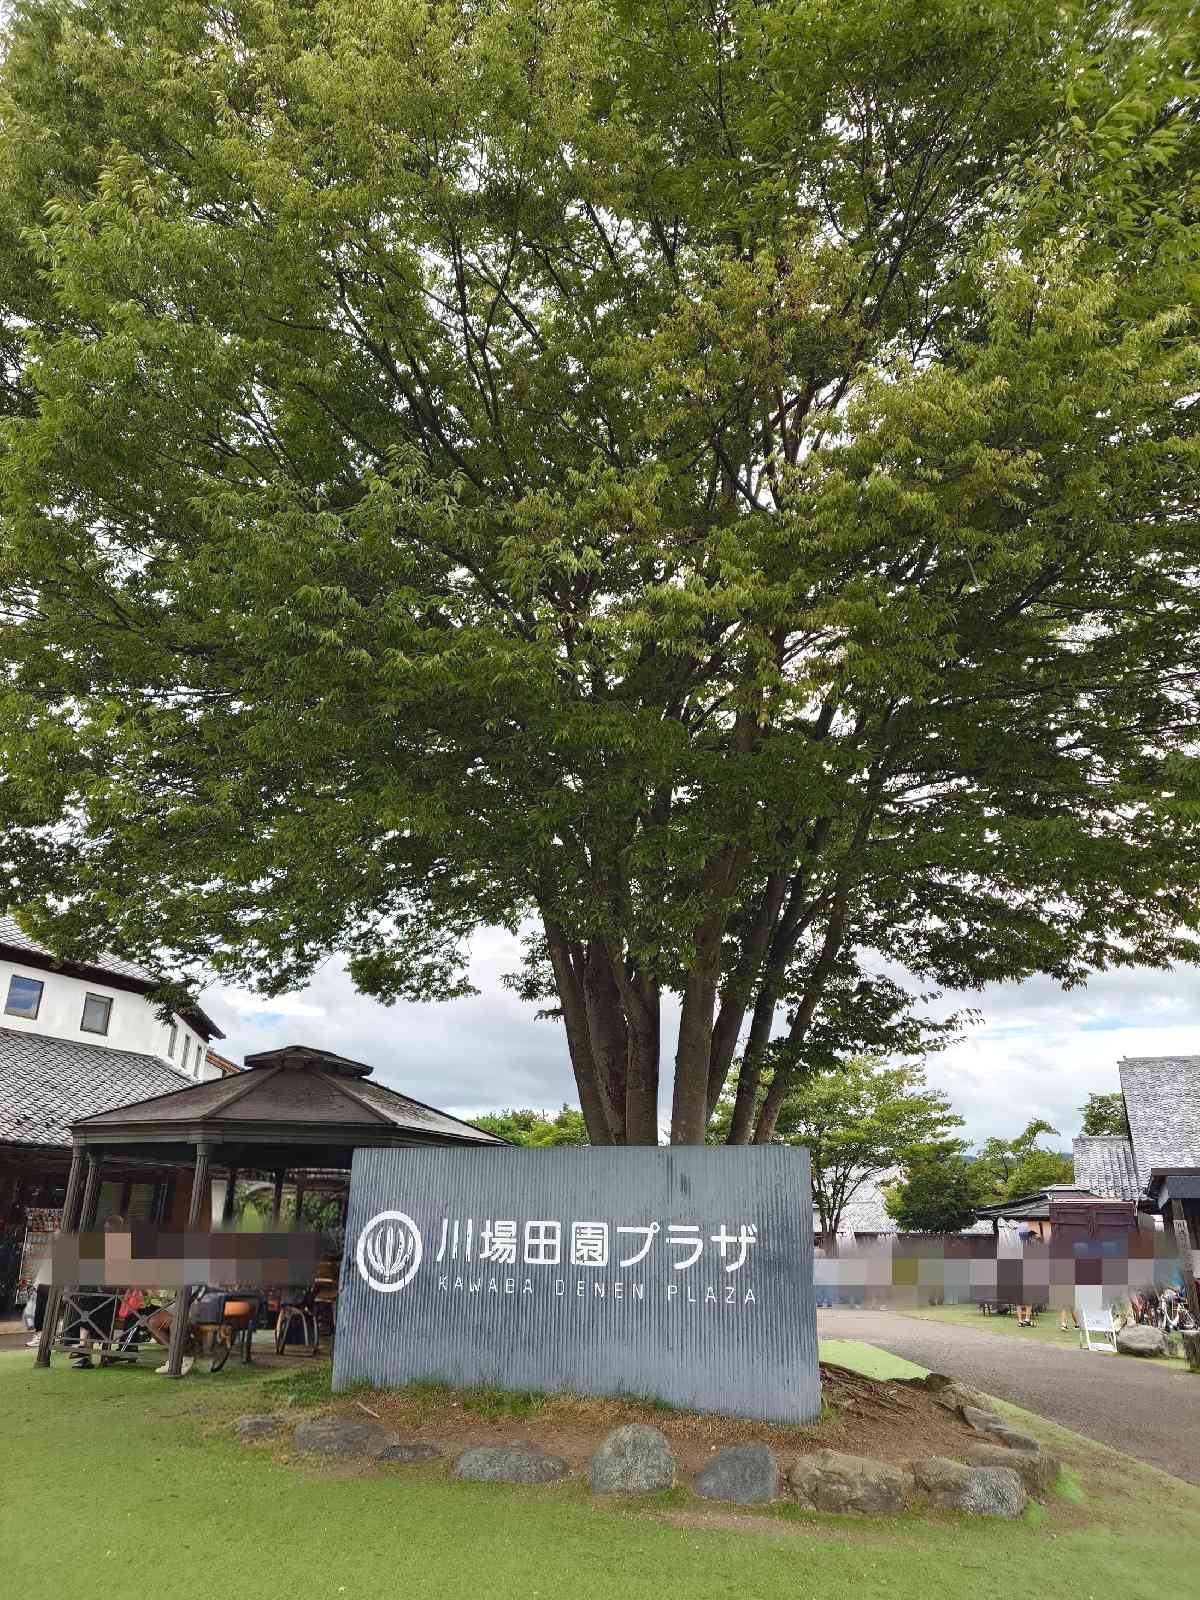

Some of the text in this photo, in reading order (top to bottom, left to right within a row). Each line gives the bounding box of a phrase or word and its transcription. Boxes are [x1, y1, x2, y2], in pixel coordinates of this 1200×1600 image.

[436, 1218, 758, 1273] 川場田園プラザ
[438, 1275, 757, 1305] KAWABA DENEN PLAZA
